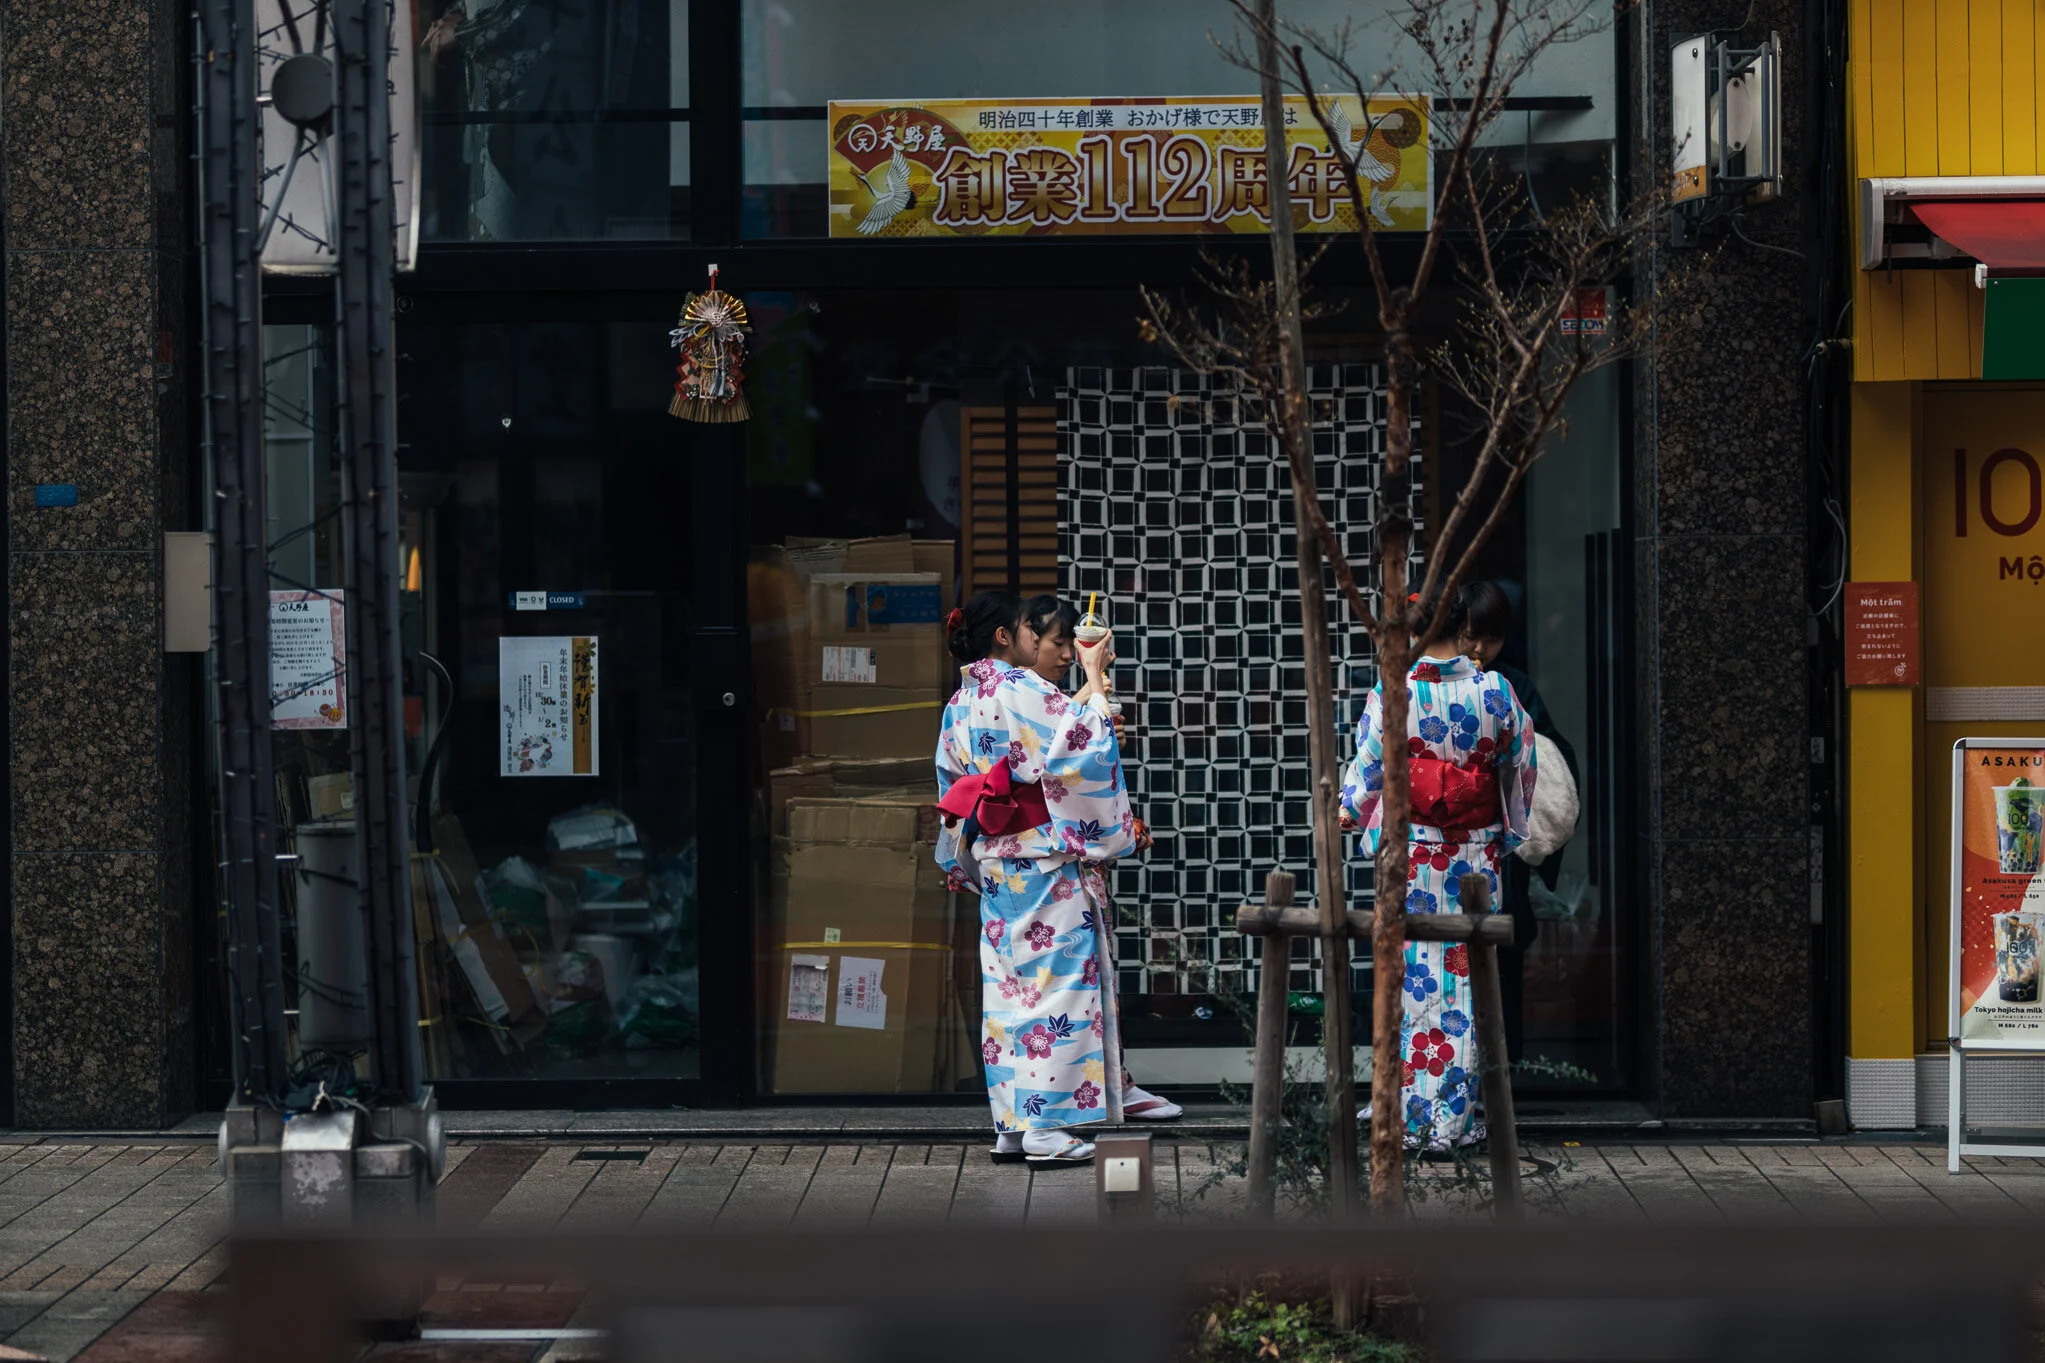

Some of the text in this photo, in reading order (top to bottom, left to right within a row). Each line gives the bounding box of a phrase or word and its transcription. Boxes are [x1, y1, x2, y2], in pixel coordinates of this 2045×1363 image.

[978, 107, 1298, 129] 明治四十年創業 おかげ様で天野は
[880, 124, 947, 153] 天野屋
[933, 134, 1355, 226] 創業112周年
[549, 596, 574, 604] CLOSED
[559, 648, 568, 741] 年末年始休業のお知らせ
[1974, 1006, 1996, 1014] Tokyo
[1997, 1006, 2025, 1014] hojicha
